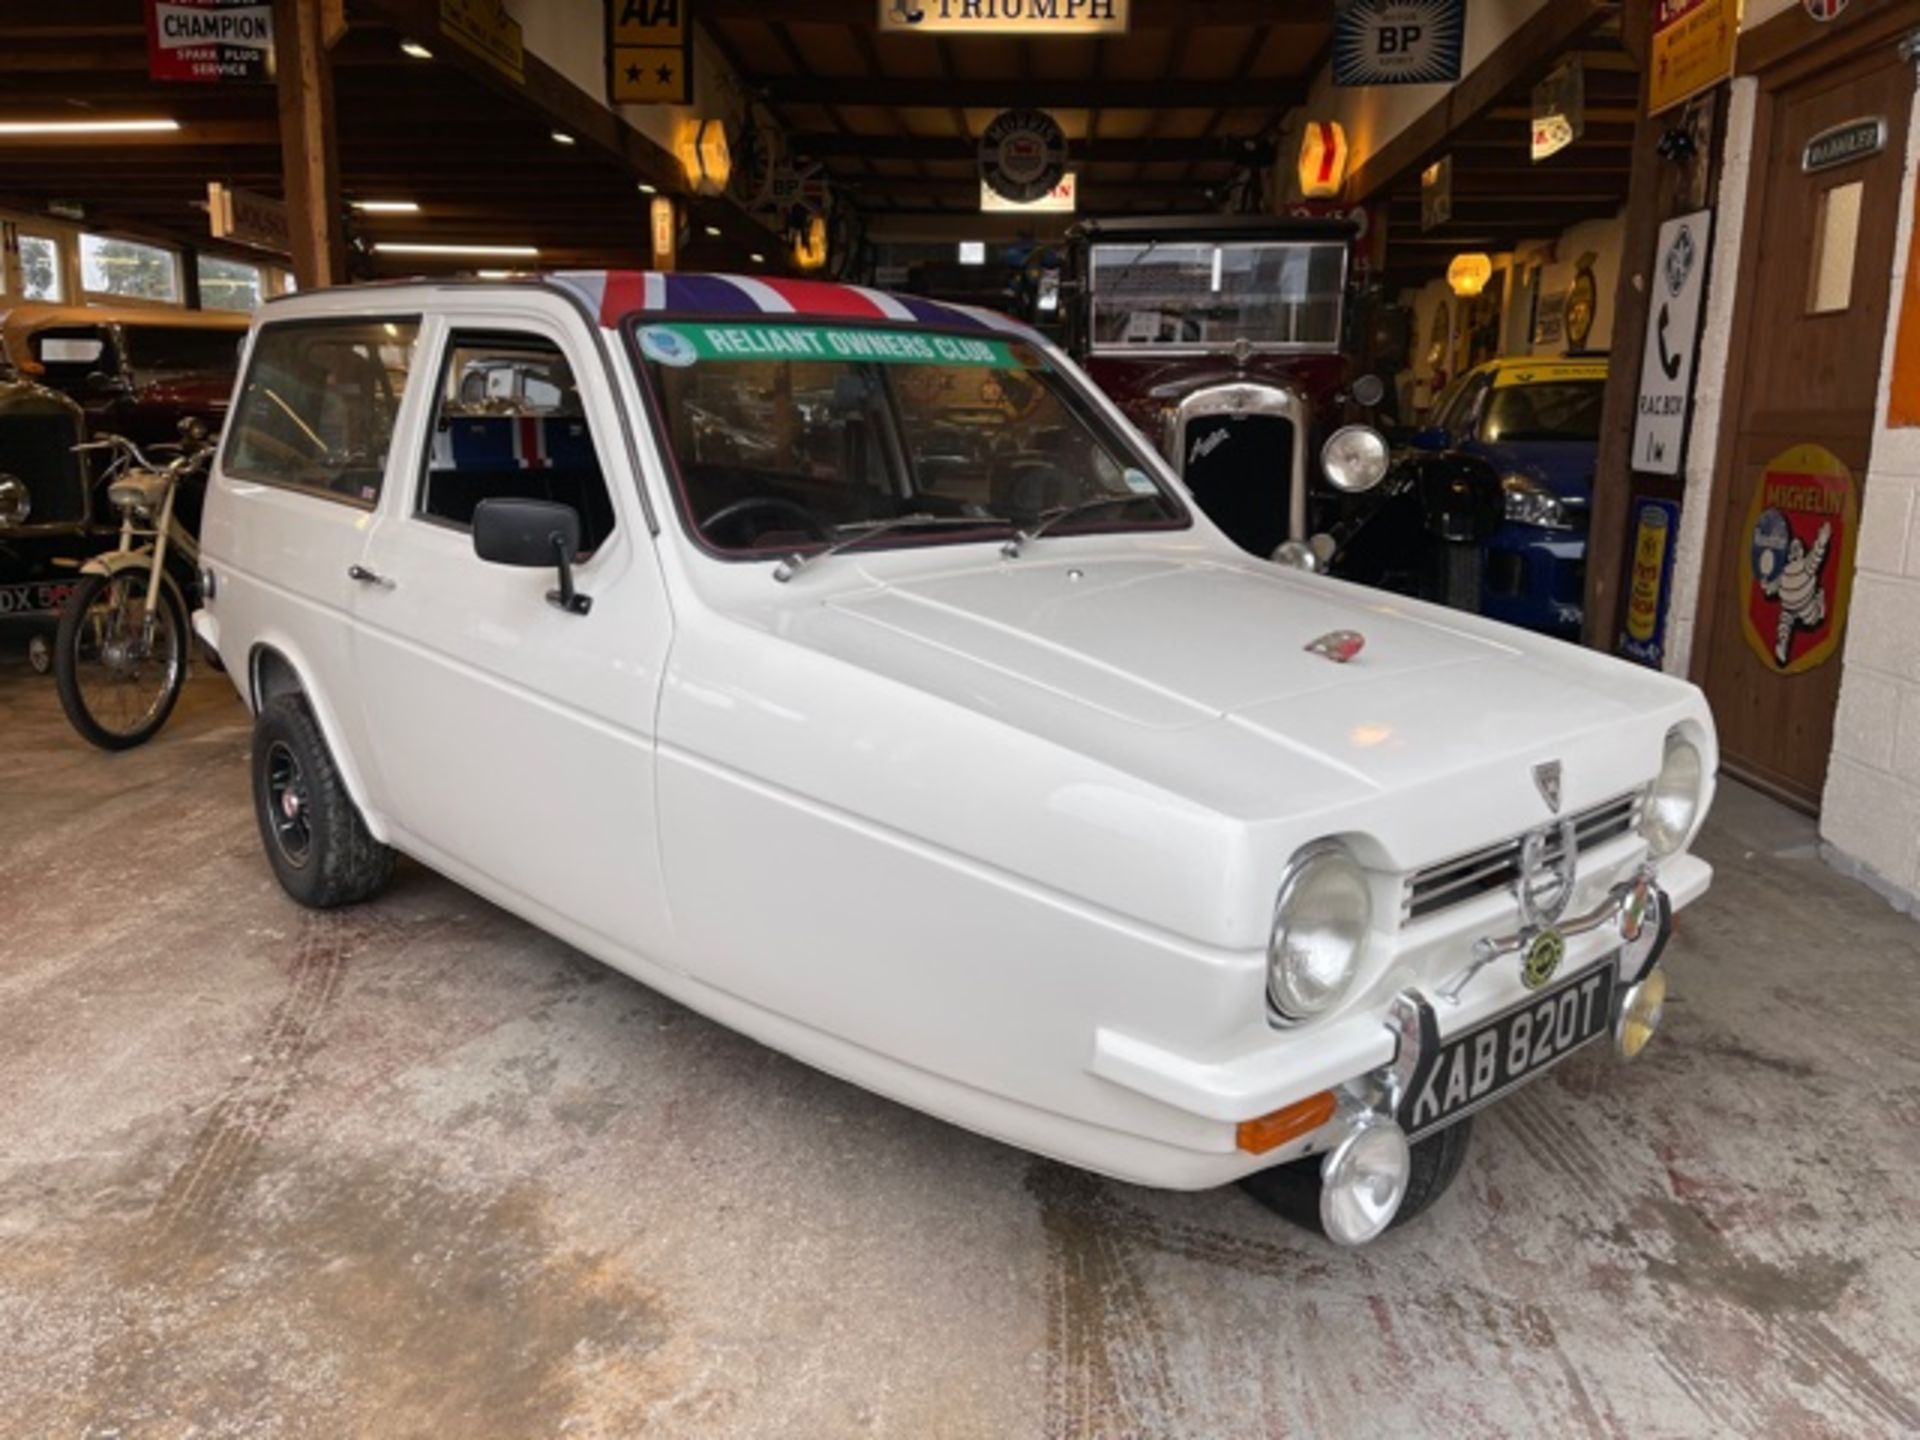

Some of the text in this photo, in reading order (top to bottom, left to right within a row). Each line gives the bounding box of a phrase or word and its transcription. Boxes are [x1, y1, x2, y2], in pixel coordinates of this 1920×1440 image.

[620, 0, 678, 27] AA
[937, 0, 1115, 19] TRIUMPH
[164, 14, 267, 39] CHAMPION
[1378, 26, 1421, 54] BP
[177, 48, 259, 61] SPARK PLUG
[192, 63, 247, 76] SERVICE
[703, 328, 825, 355] RELIANT
[827, 331, 937, 359] OWNERS
[932, 338, 996, 362] CLUB
[1768, 484, 1845, 514] MICHELIN
[1412, 974, 1602, 1126] KAB 820T
